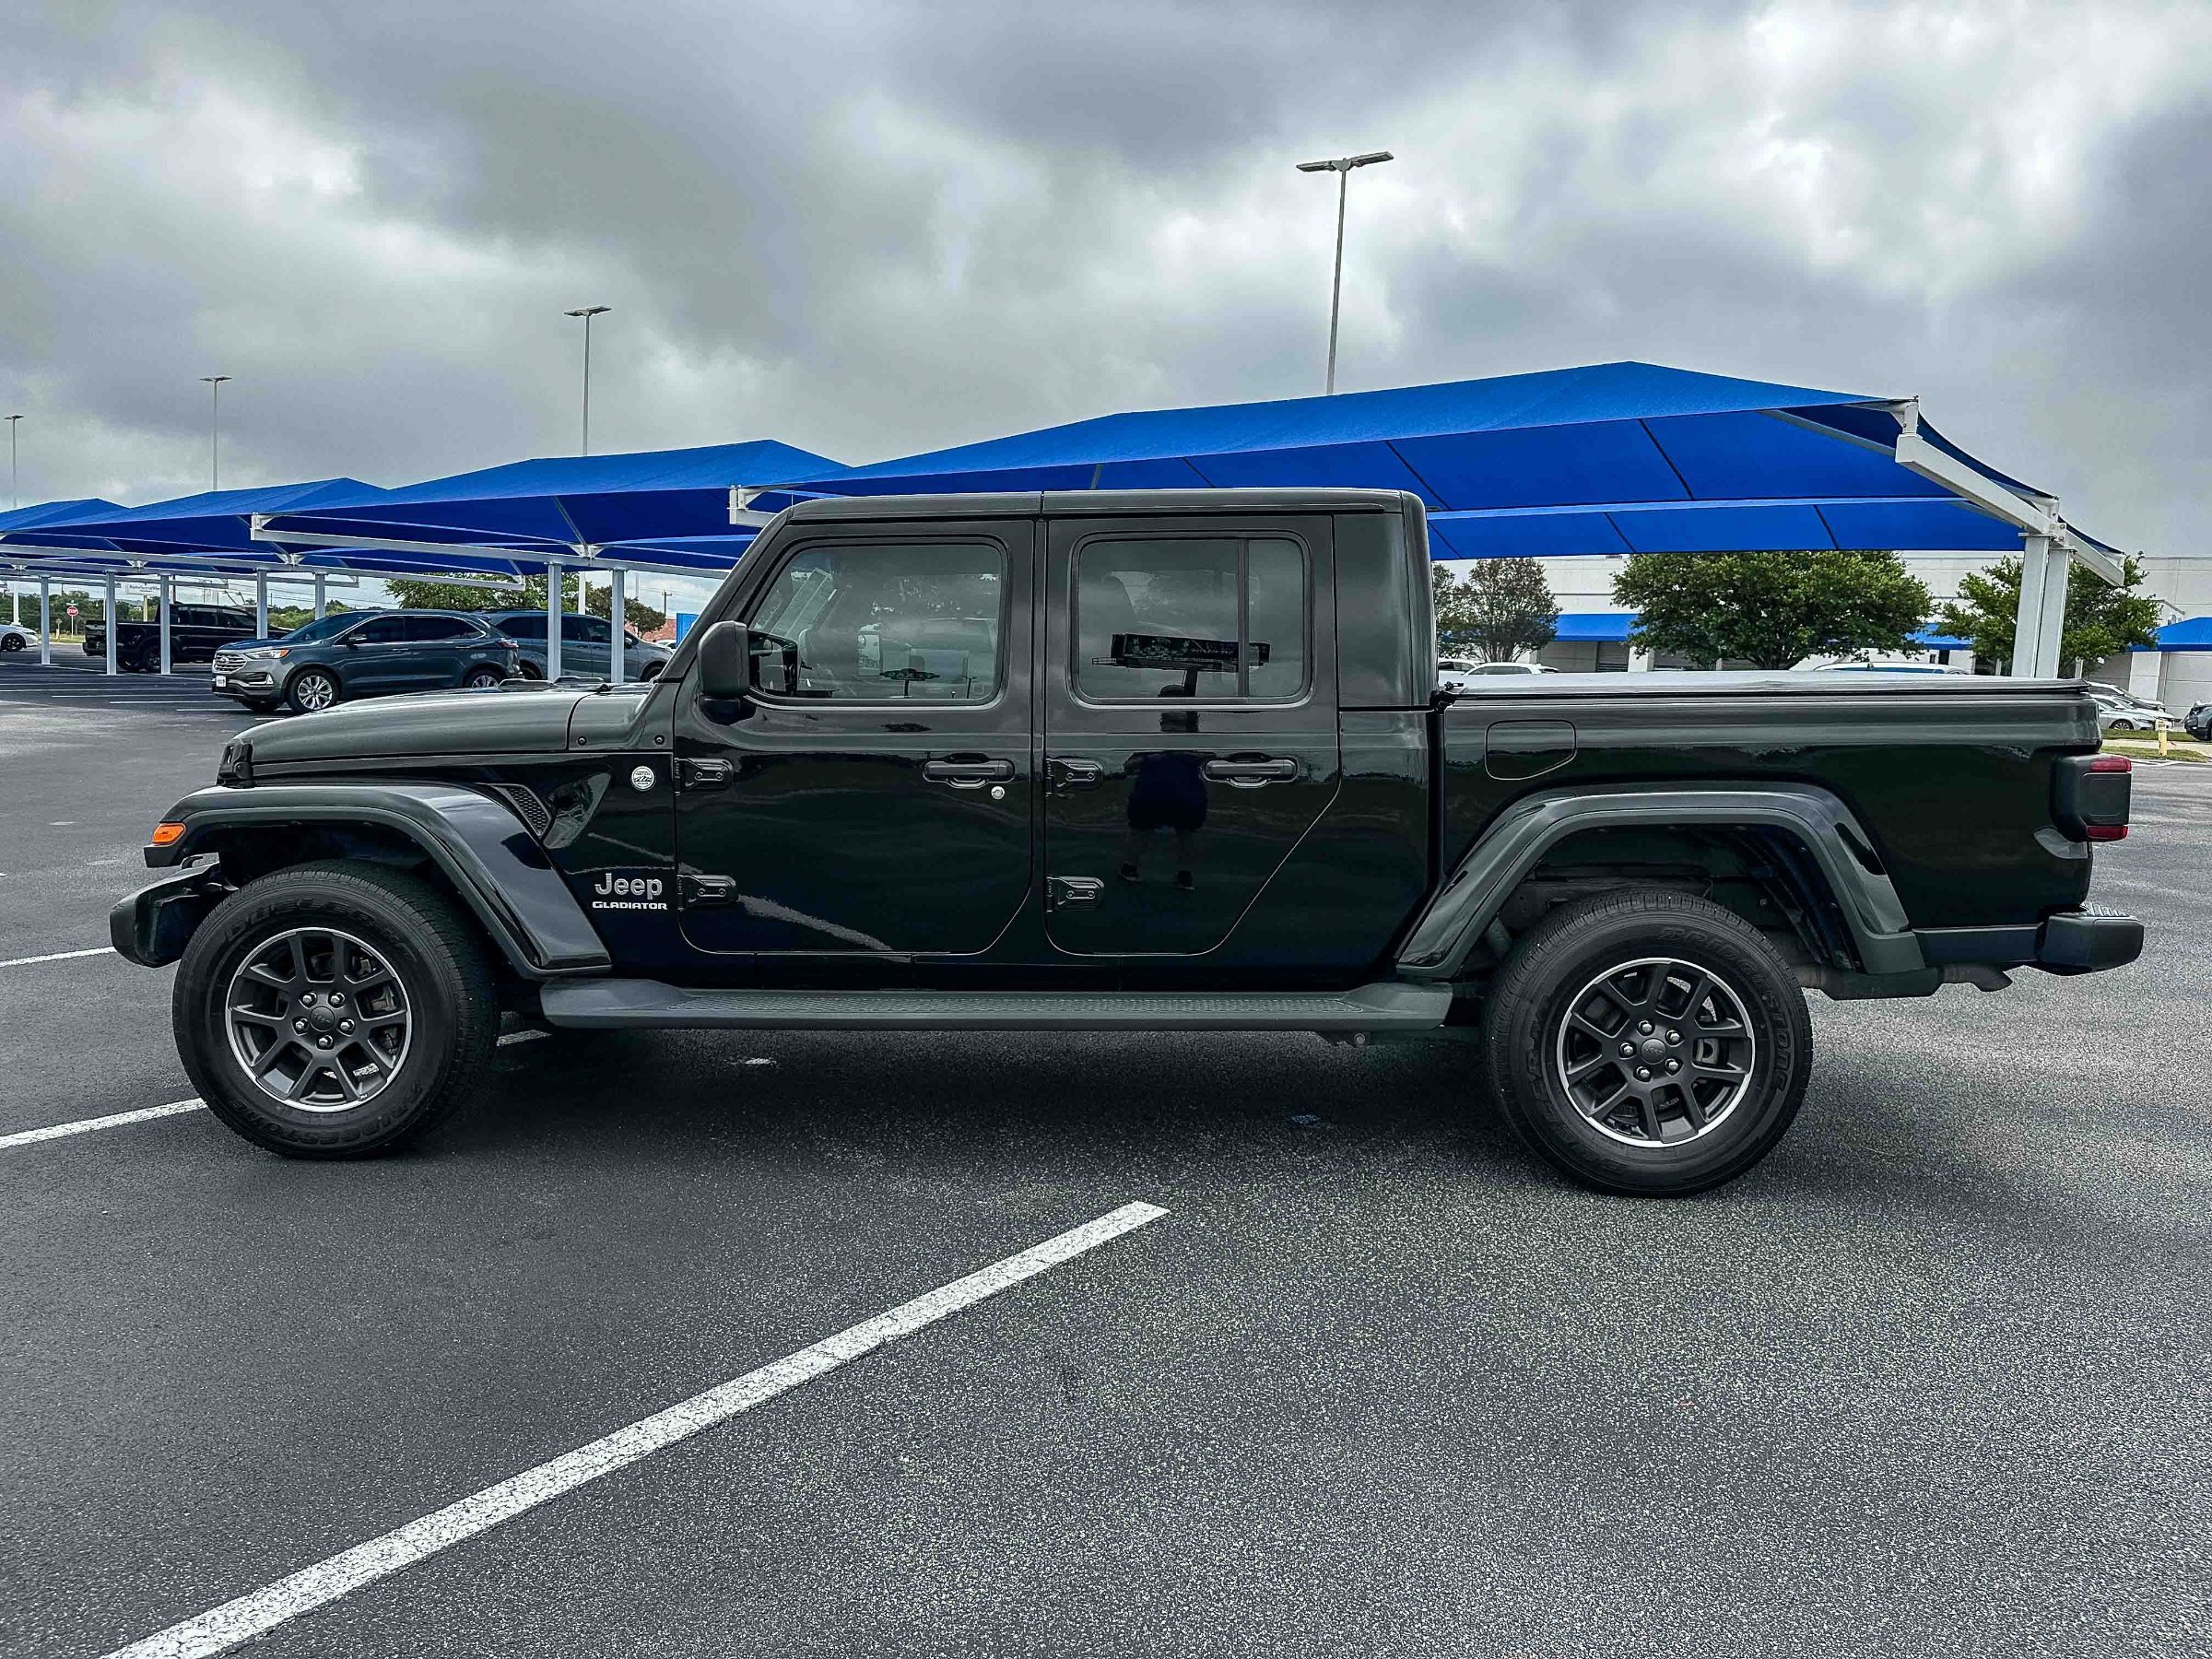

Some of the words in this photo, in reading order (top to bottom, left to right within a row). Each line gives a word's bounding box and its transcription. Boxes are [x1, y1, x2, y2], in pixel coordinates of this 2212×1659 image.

[594, 873, 663, 900] Jeep
[592, 901, 668, 910] GLADIATOR
[1659, 927, 1791, 1091] BRIDGESTONE
